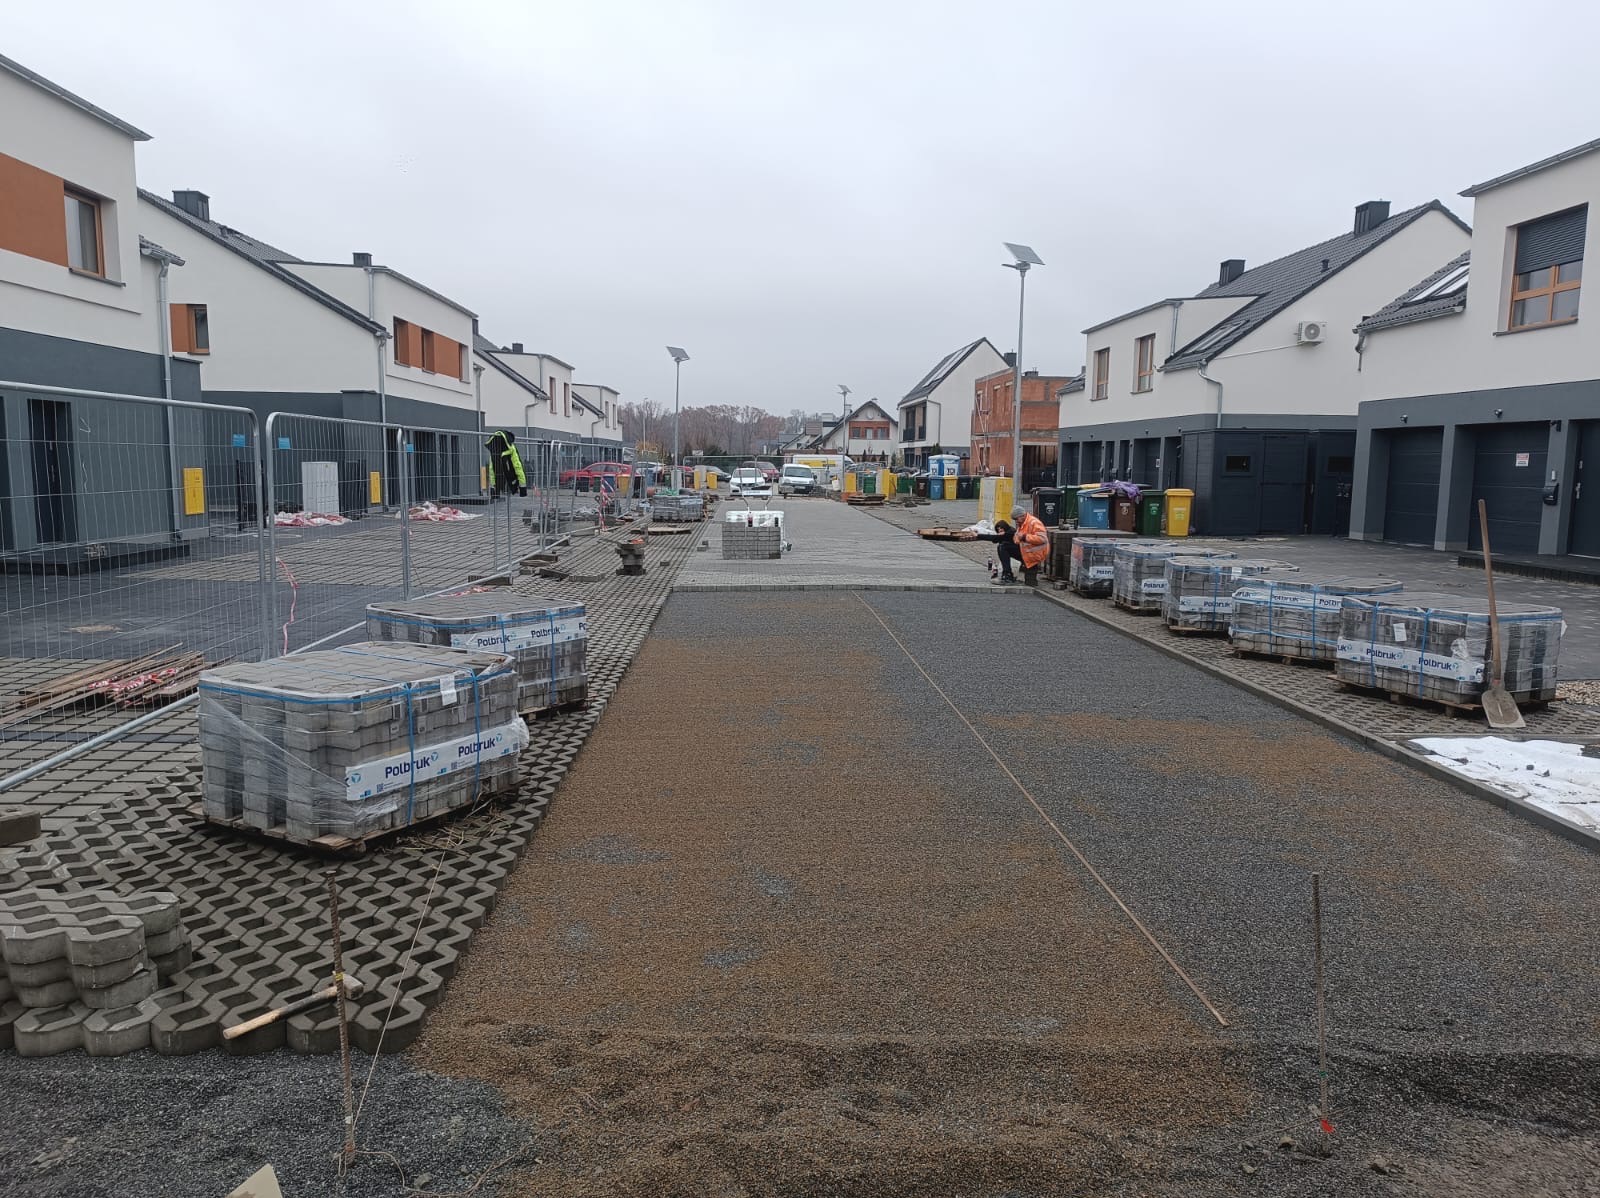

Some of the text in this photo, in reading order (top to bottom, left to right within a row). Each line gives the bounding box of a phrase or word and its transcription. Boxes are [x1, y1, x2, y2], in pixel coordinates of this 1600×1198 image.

[531, 626, 561, 639] Polbruk
[477, 634, 511, 648] Polbruk
[1366, 648, 1397, 660] Polbruk
[458, 737, 496, 757] Polbruk
